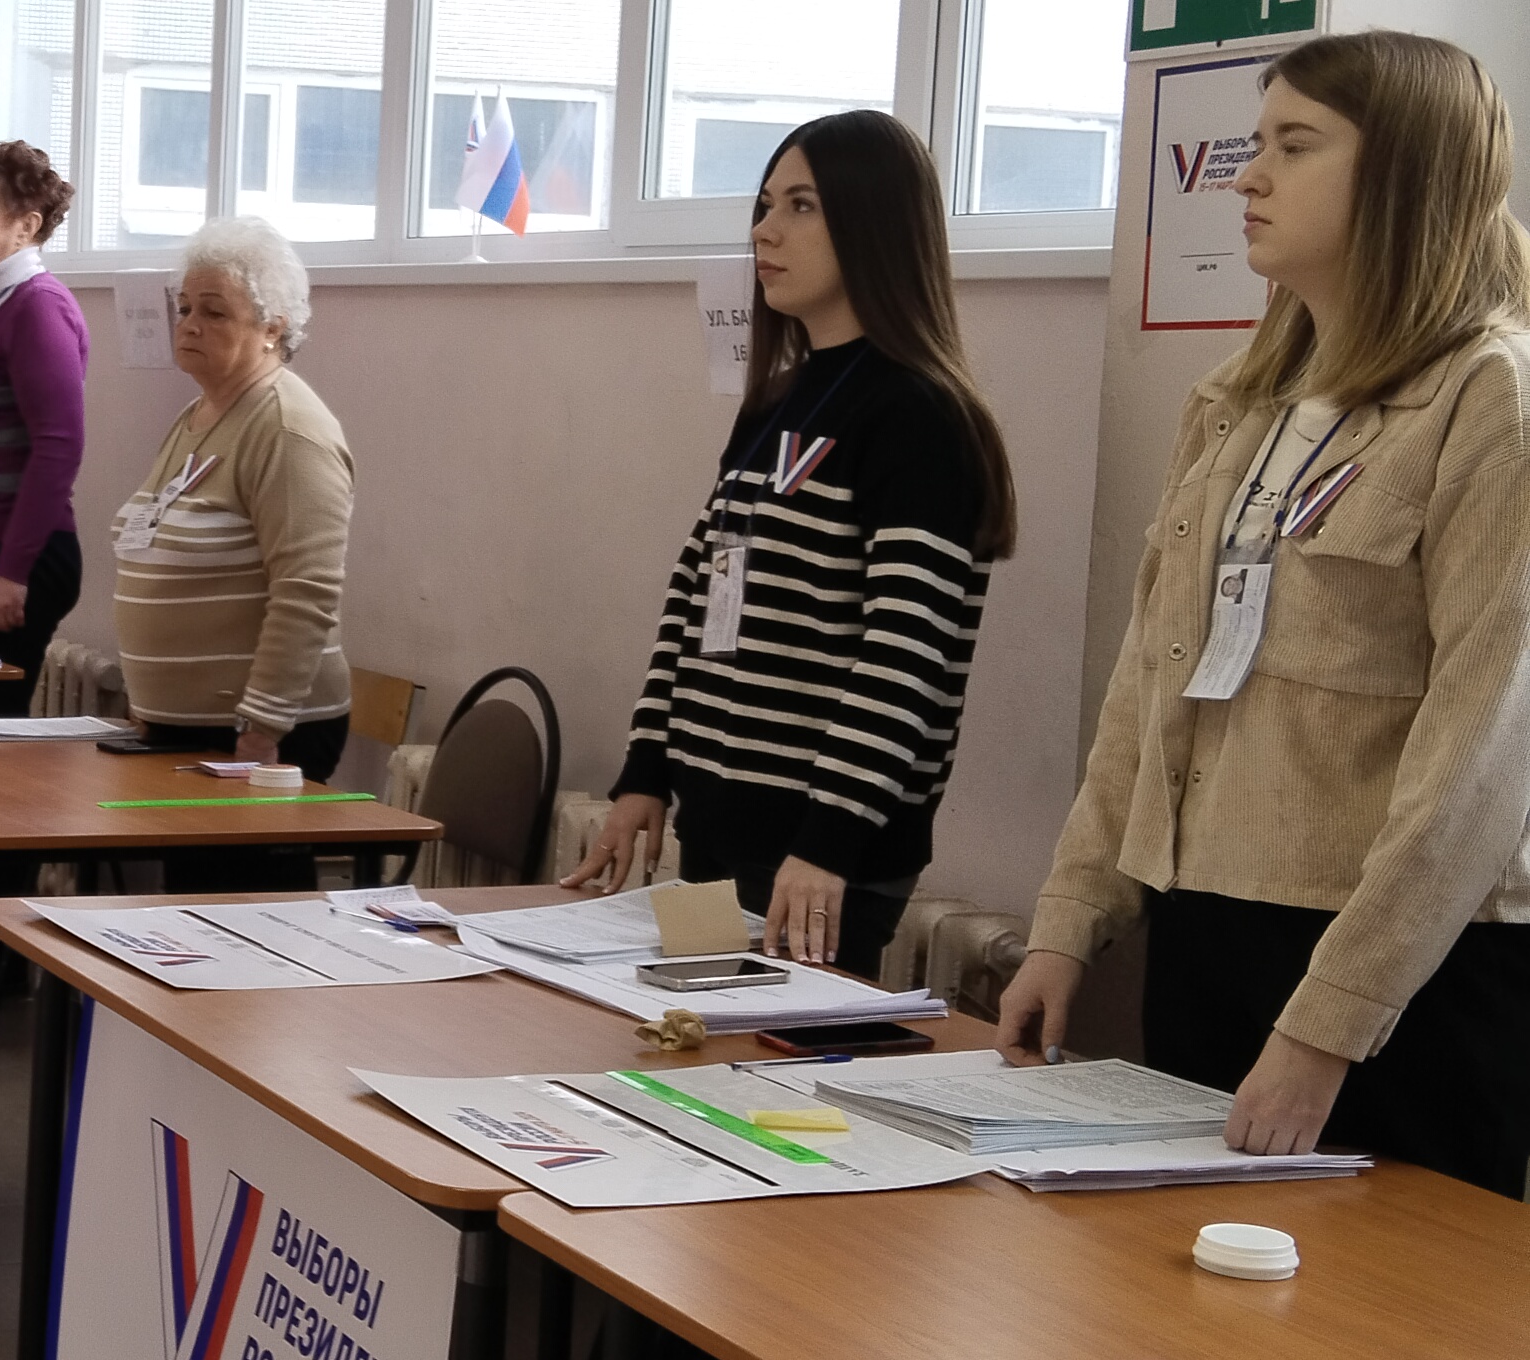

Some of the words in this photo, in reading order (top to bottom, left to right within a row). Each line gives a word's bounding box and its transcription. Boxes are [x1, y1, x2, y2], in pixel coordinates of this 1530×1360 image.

[1207, 150, 1258, 165] ПРЕЗИДЕНТ
[1202, 166, 1238, 180] РОССИИ
[706, 309, 729, 327] УЛ.
[271, 1207, 384, 1329] ВЫБОРЫ
